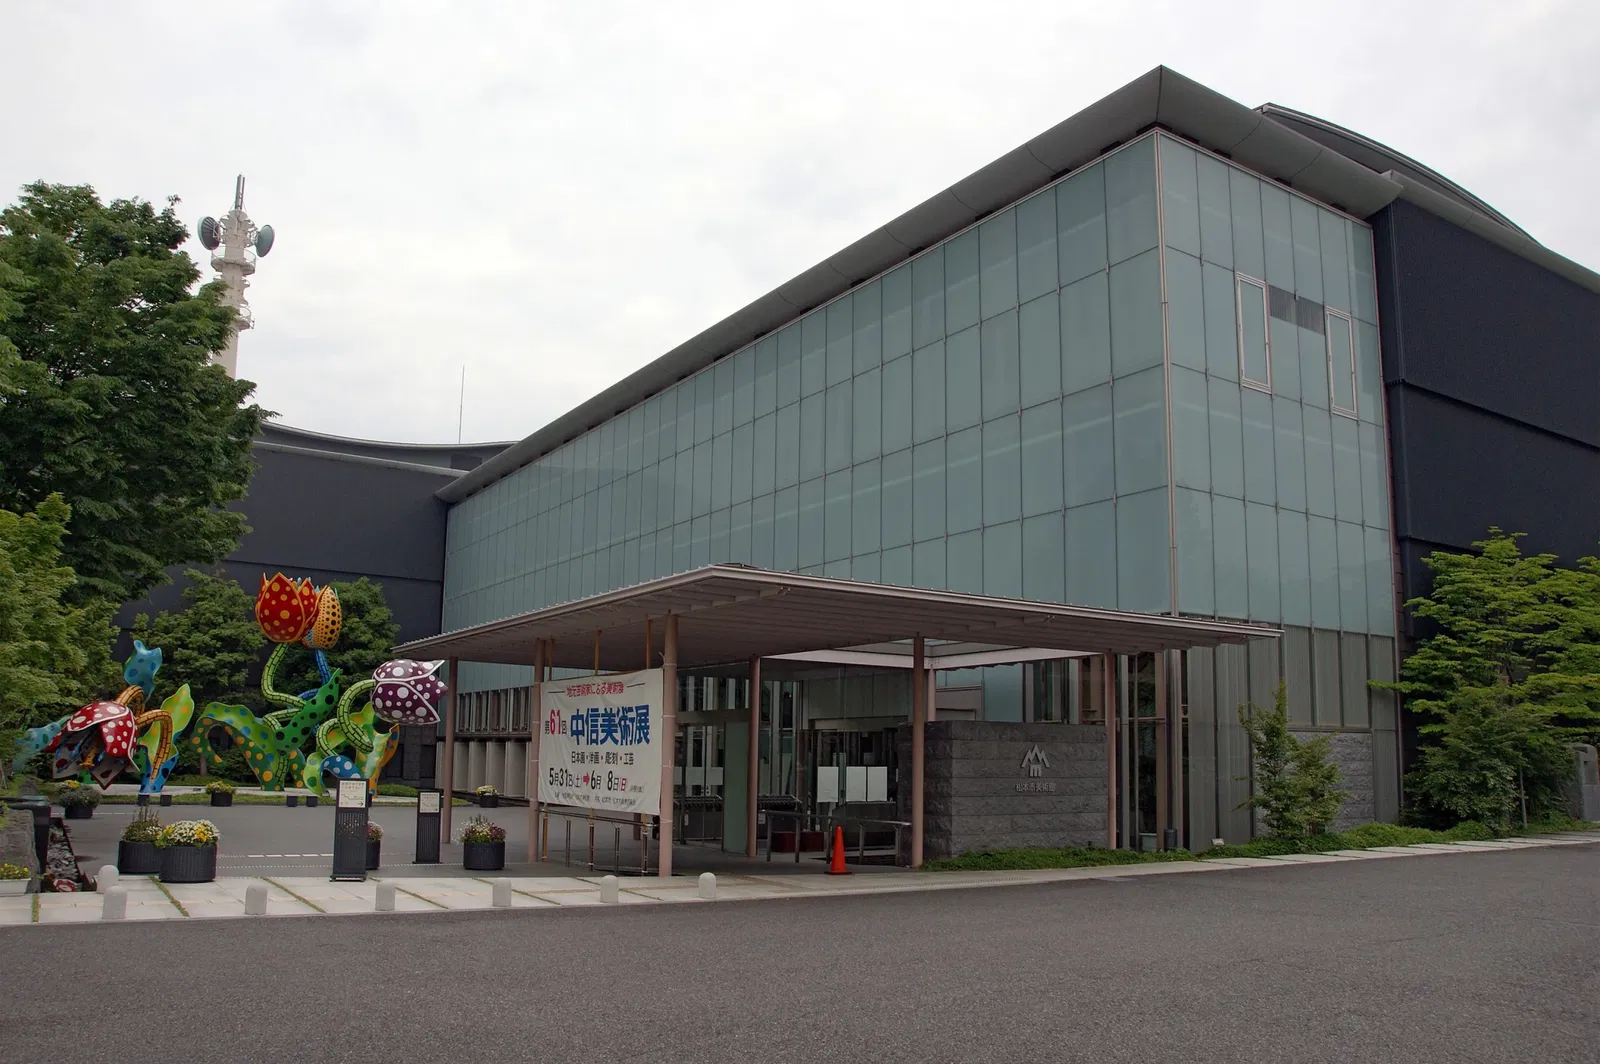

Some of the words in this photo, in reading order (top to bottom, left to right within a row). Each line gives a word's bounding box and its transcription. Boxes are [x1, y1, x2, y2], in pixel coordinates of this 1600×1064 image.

[570, 704, 650, 746] 中信美術展
